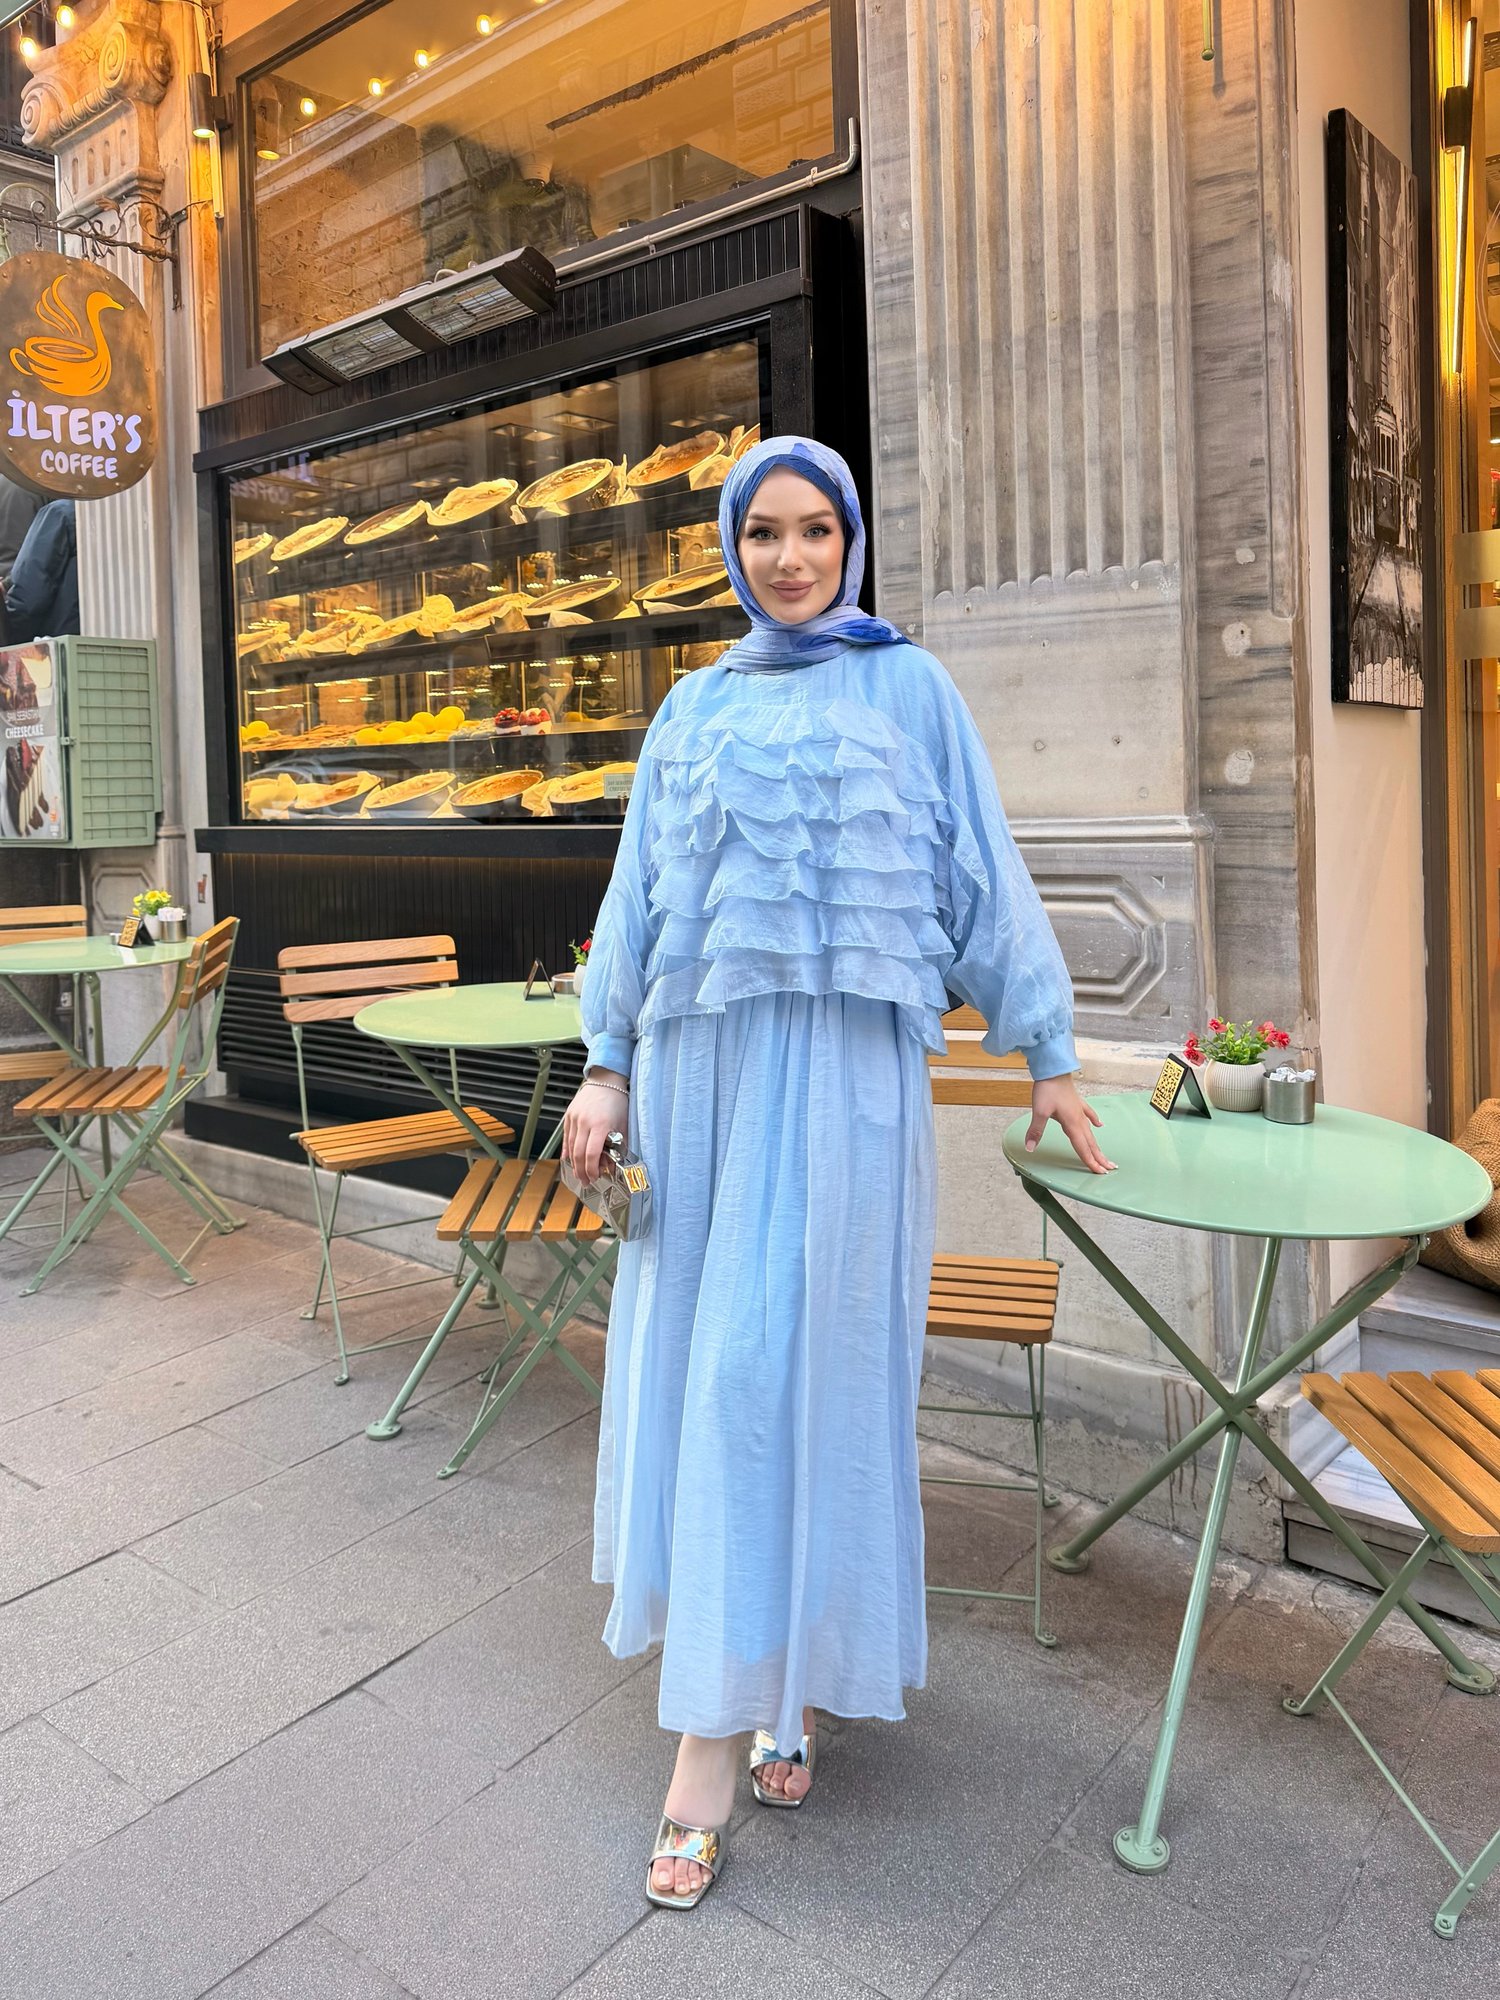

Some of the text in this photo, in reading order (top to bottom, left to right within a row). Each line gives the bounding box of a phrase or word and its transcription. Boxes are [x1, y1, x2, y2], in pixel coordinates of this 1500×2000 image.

[6, 389, 142, 453] İLTER'S
[40, 449, 118, 479] COFFEE
[5, 724, 44, 739] CHEESECAKE
